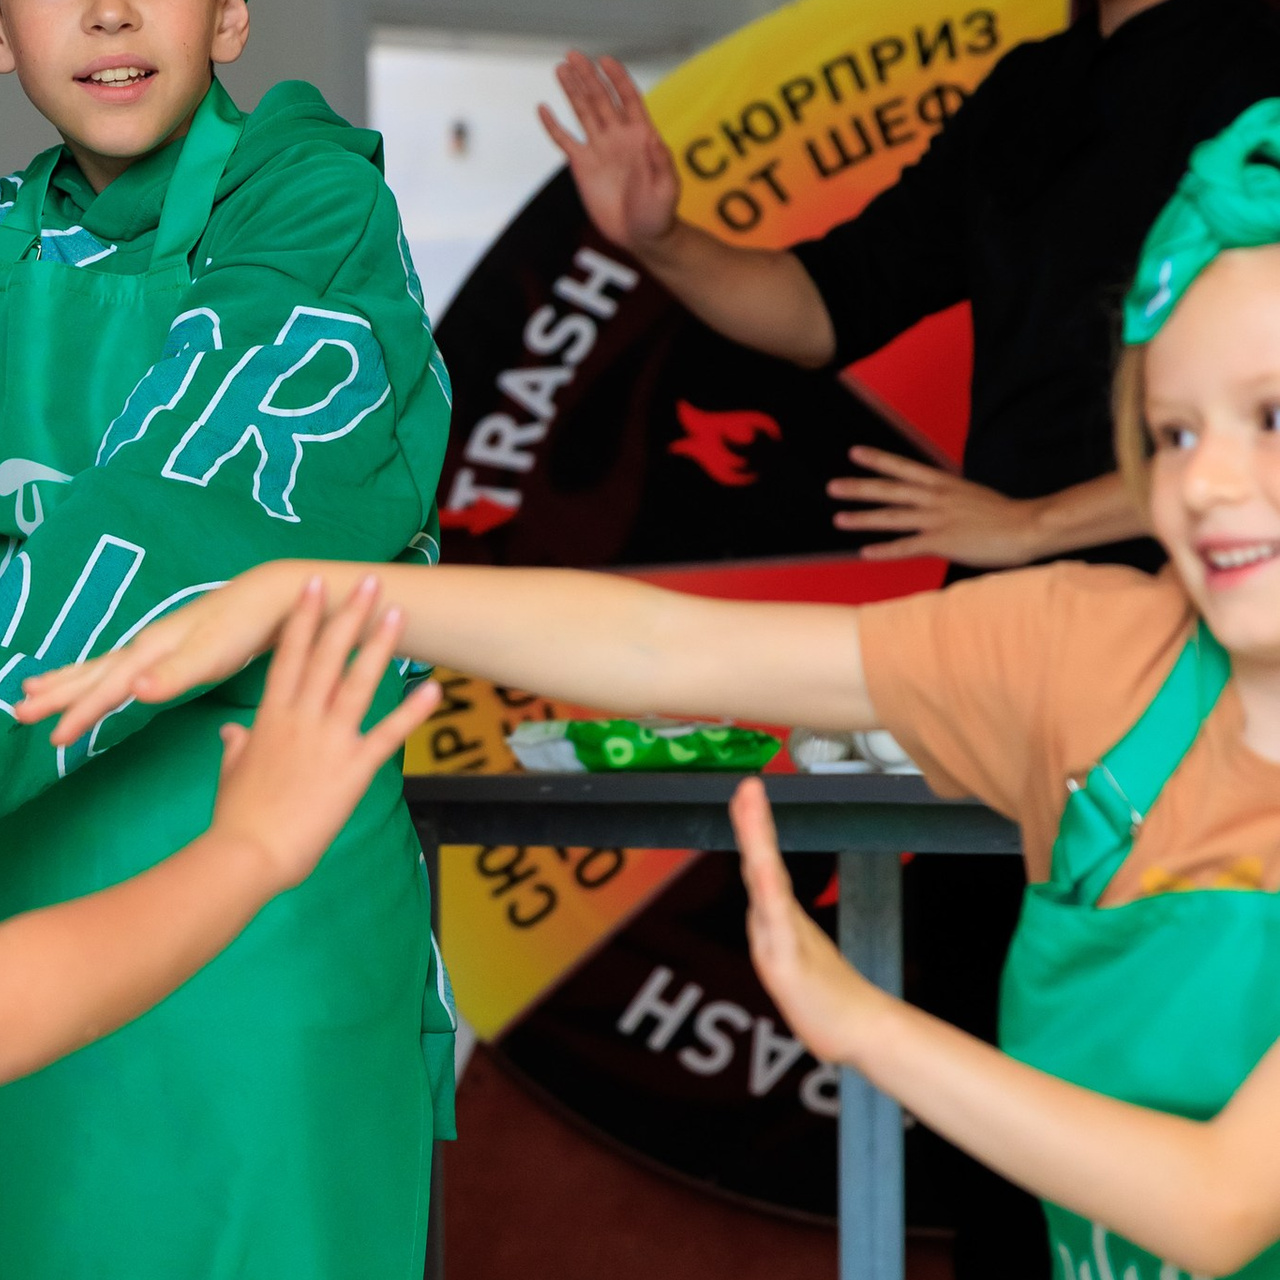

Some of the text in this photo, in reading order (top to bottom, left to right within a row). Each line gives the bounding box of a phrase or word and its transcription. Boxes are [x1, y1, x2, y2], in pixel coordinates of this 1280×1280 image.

[685, 9, 1000, 180] СЮРПРИЗ
[716, 80, 966, 232] ОТ ШЕФ
[446, 247, 641, 511] TRASH
